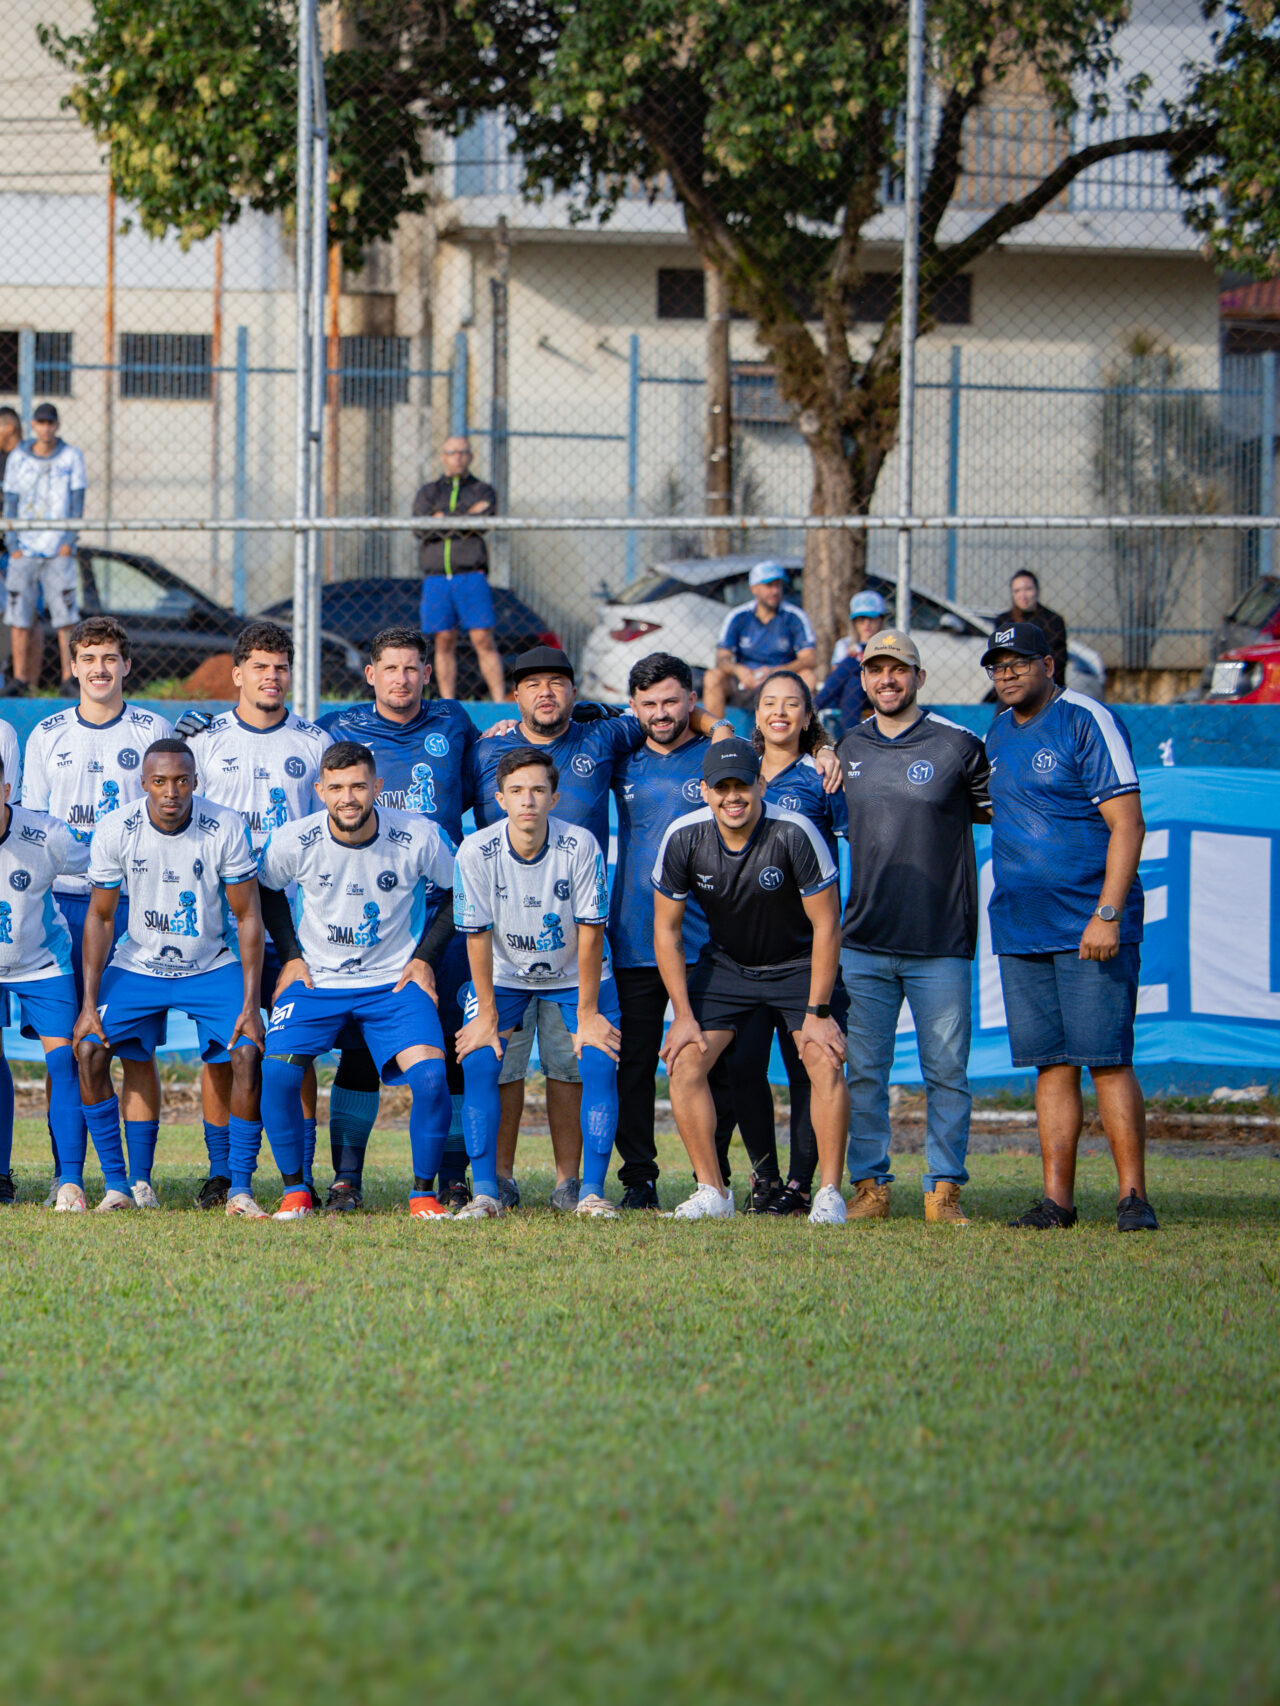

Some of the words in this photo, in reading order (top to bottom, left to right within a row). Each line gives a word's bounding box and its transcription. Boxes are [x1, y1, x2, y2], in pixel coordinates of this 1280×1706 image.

[40, 714, 65, 730] WR
[130, 712, 154, 726] WR
[296, 720, 322, 737] WR
[198, 813, 220, 831] WR
[21, 825, 47, 842] WR
[298, 825, 322, 845] WR
[388, 827, 413, 843] WR
[557, 835, 578, 850] WR
[697, 882, 714, 890] TUTI
